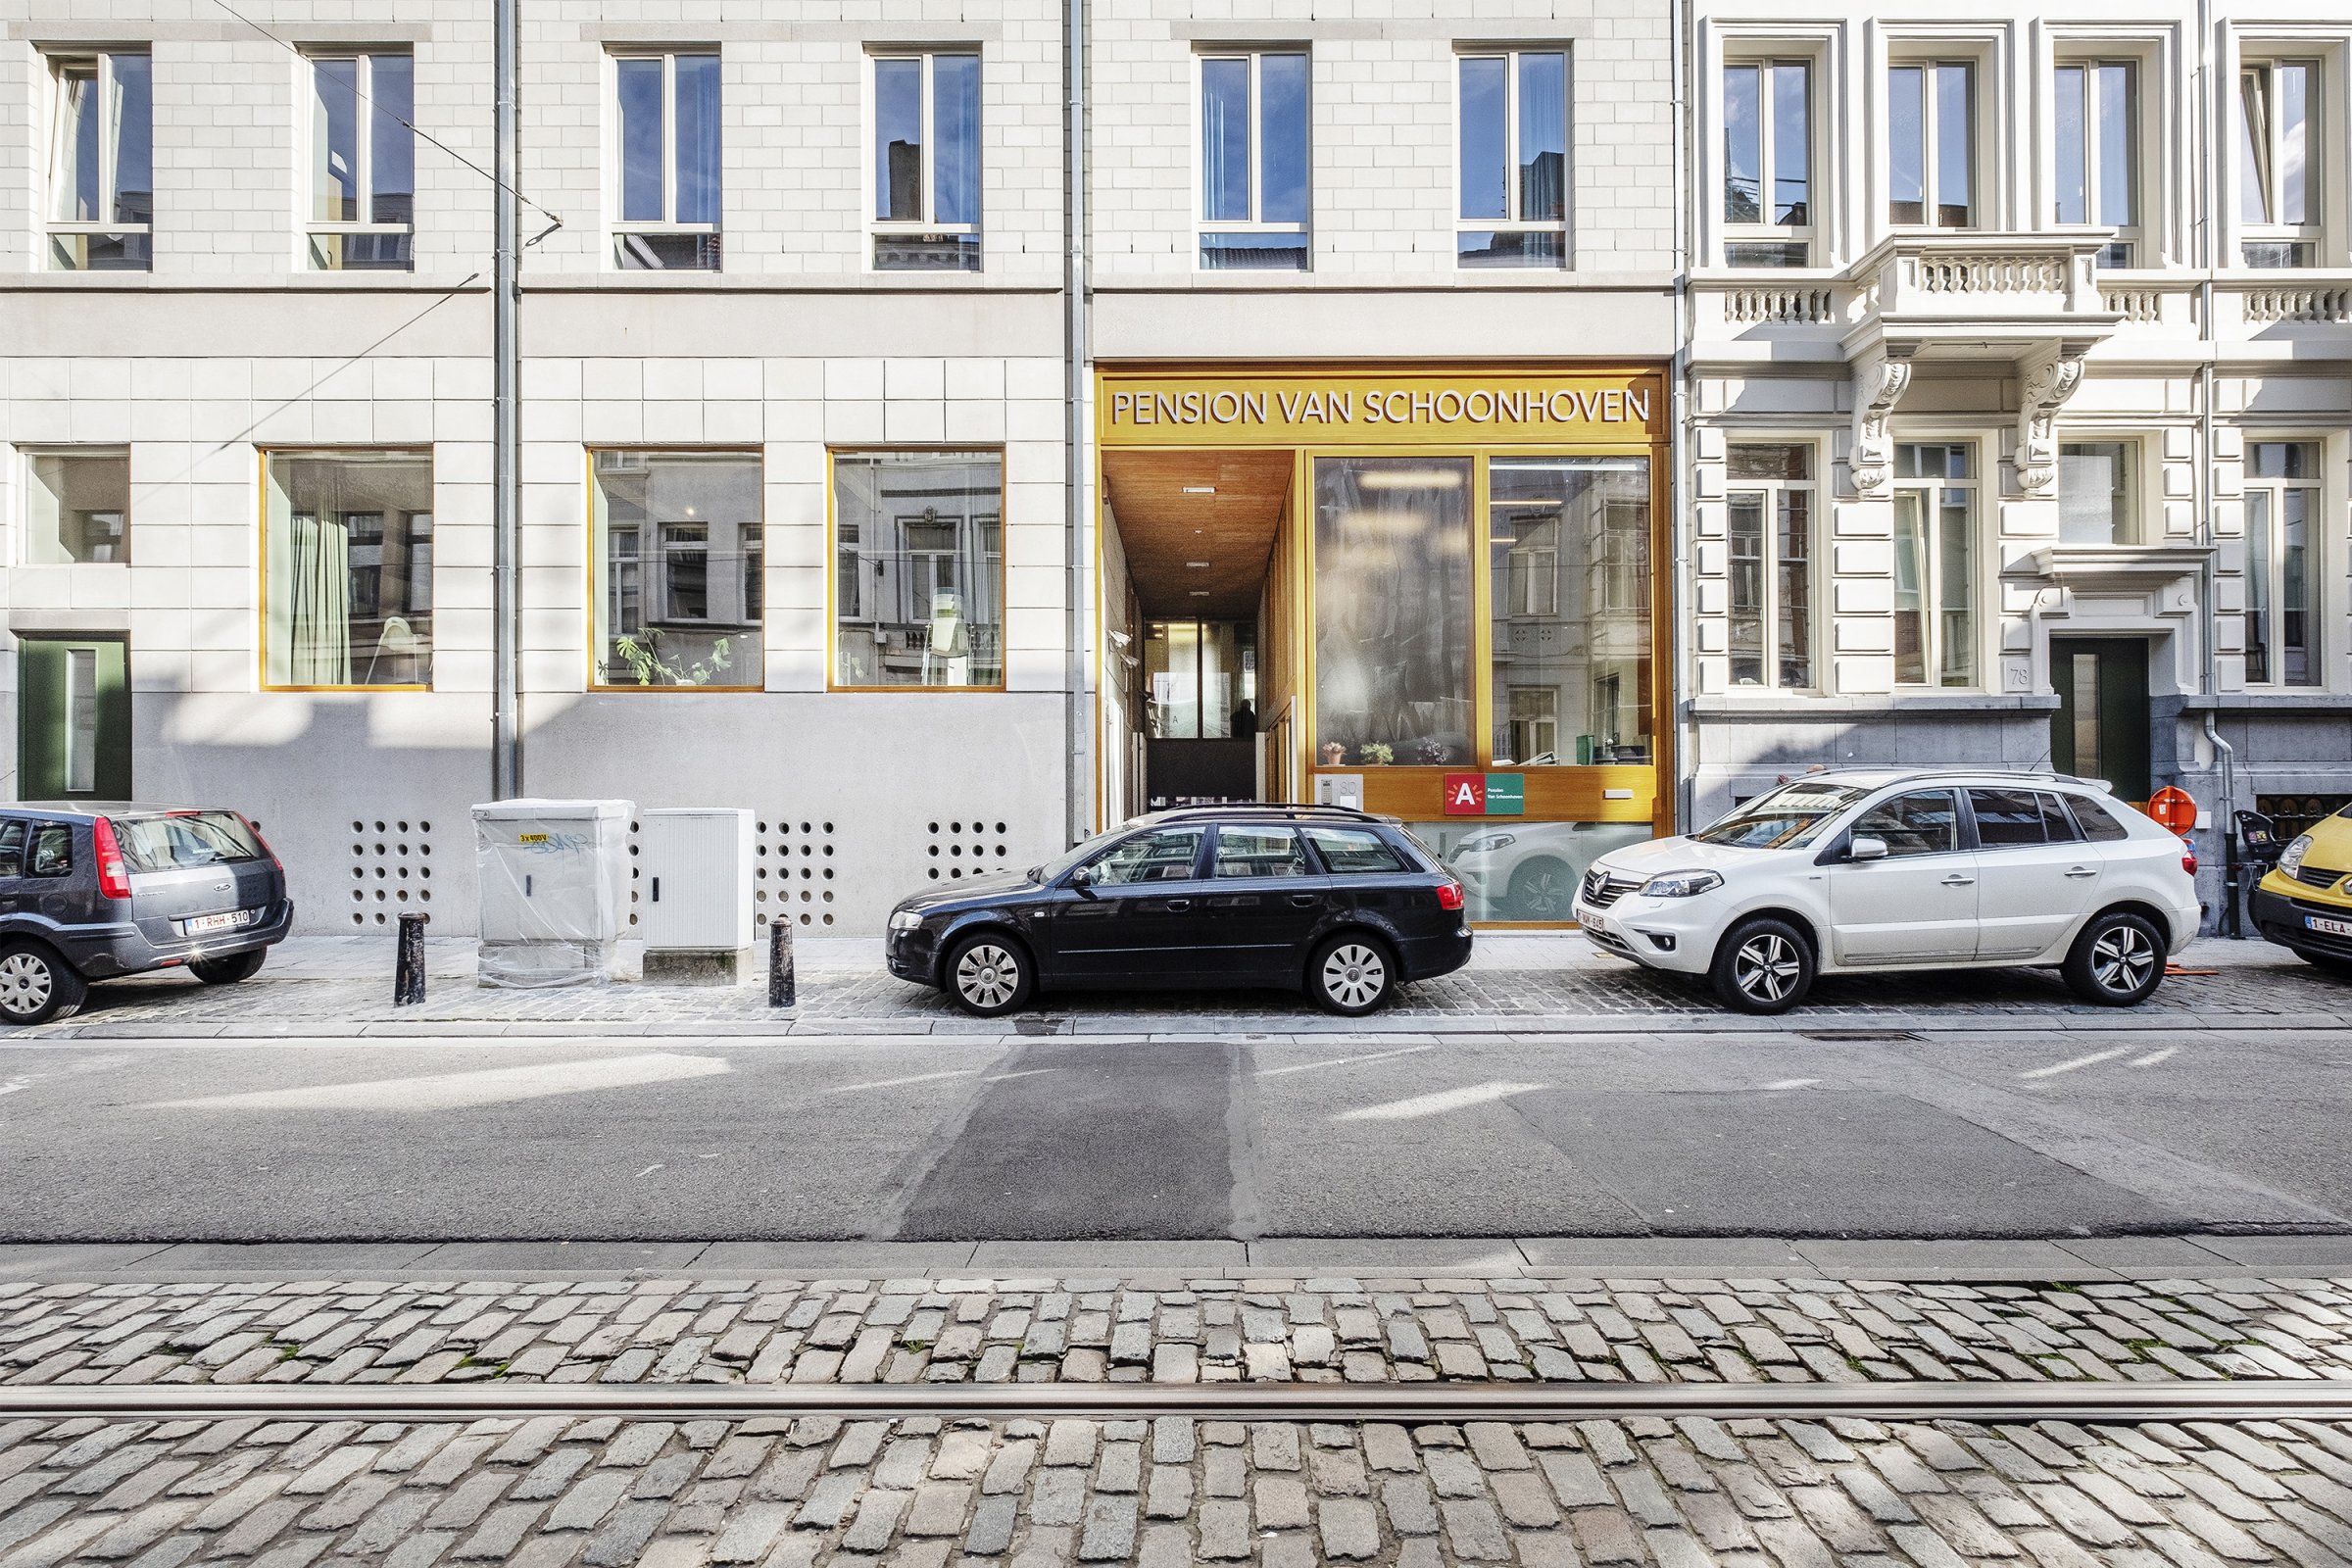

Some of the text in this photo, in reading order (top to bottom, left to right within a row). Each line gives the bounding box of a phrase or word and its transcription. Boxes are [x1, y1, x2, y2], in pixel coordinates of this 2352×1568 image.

[1112, 389, 1649, 423] PENSION VAN SCHOONHOVEN
[2010, 667, 2029, 685] 78
[1455, 782, 1476, 805] A
